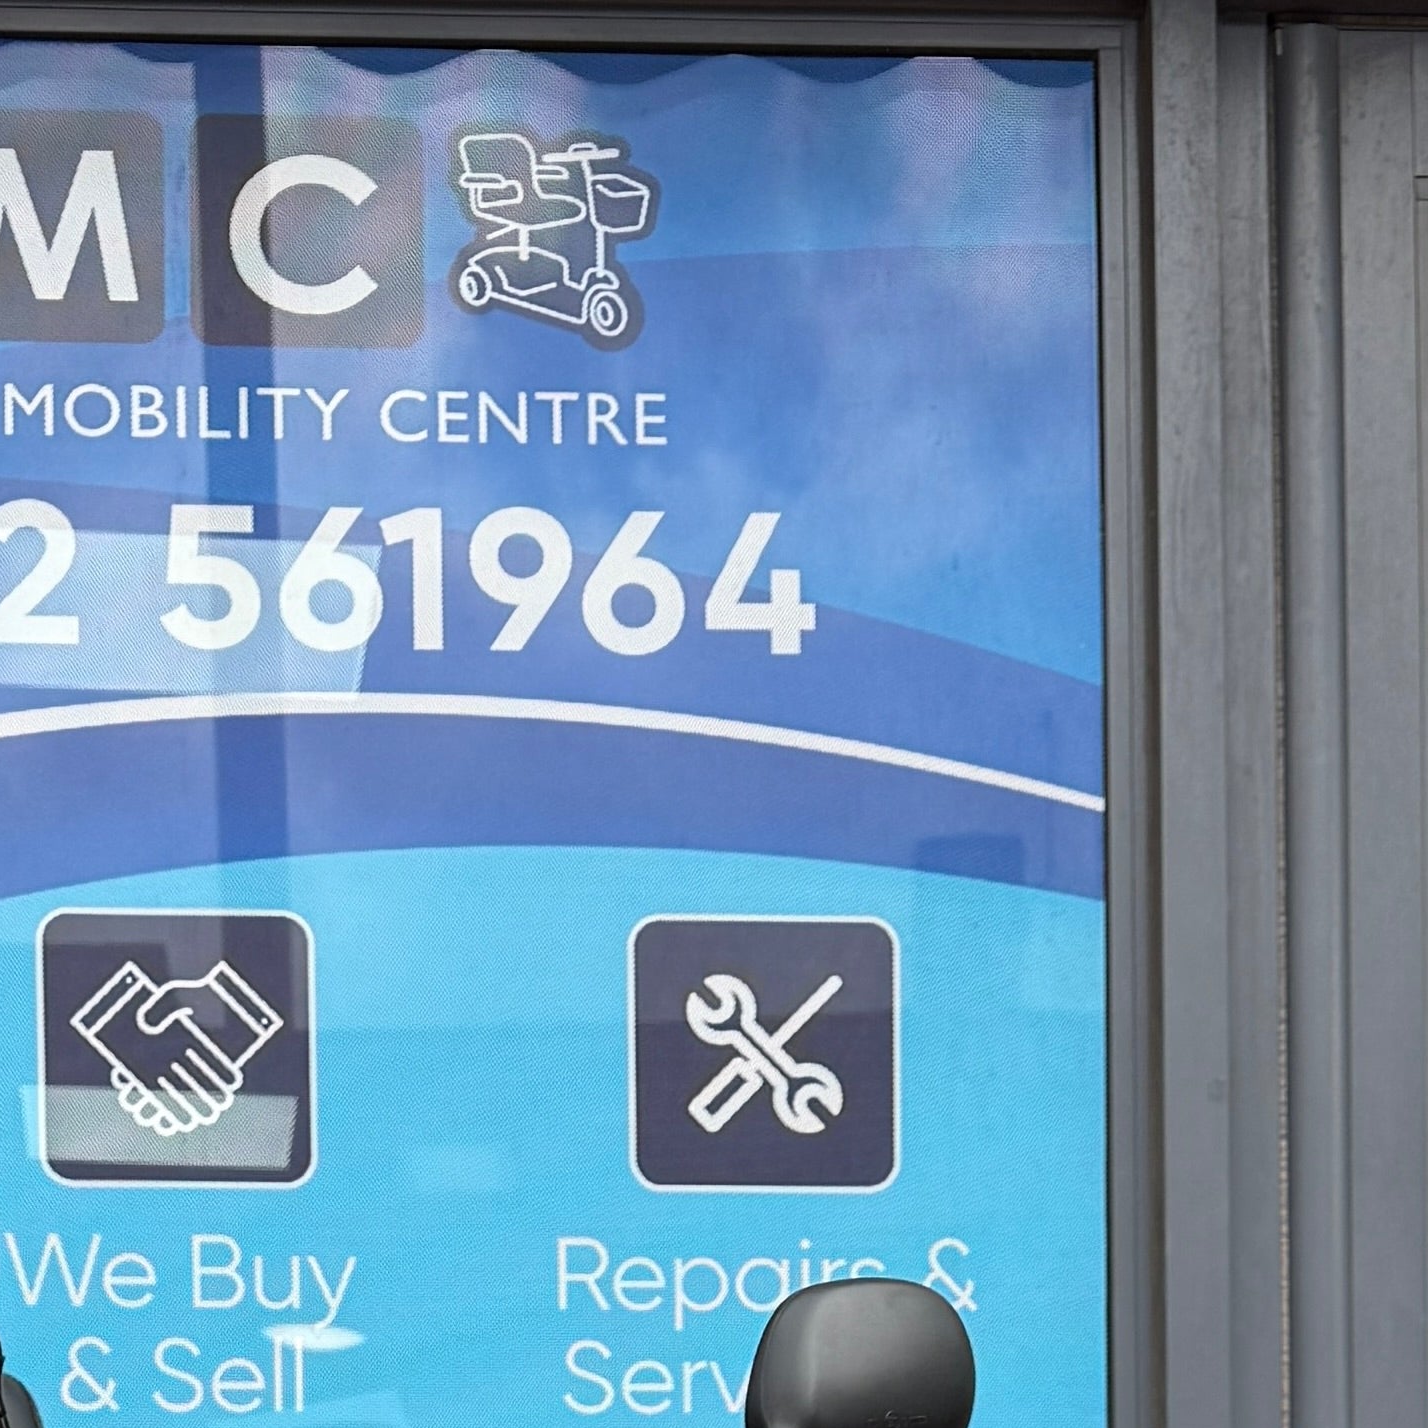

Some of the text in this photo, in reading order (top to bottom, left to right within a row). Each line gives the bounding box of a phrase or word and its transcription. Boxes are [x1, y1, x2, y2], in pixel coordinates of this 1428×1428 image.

[4, 382, 348, 442] MOBILITY
[380, 388, 669, 447] CENTRE
[162, 504, 817, 657] 561964
[3, 1232, 157, 1309] We
[190, 1233, 357, 1332] Buy
[60, 1335, 305, 1414] & Sell
